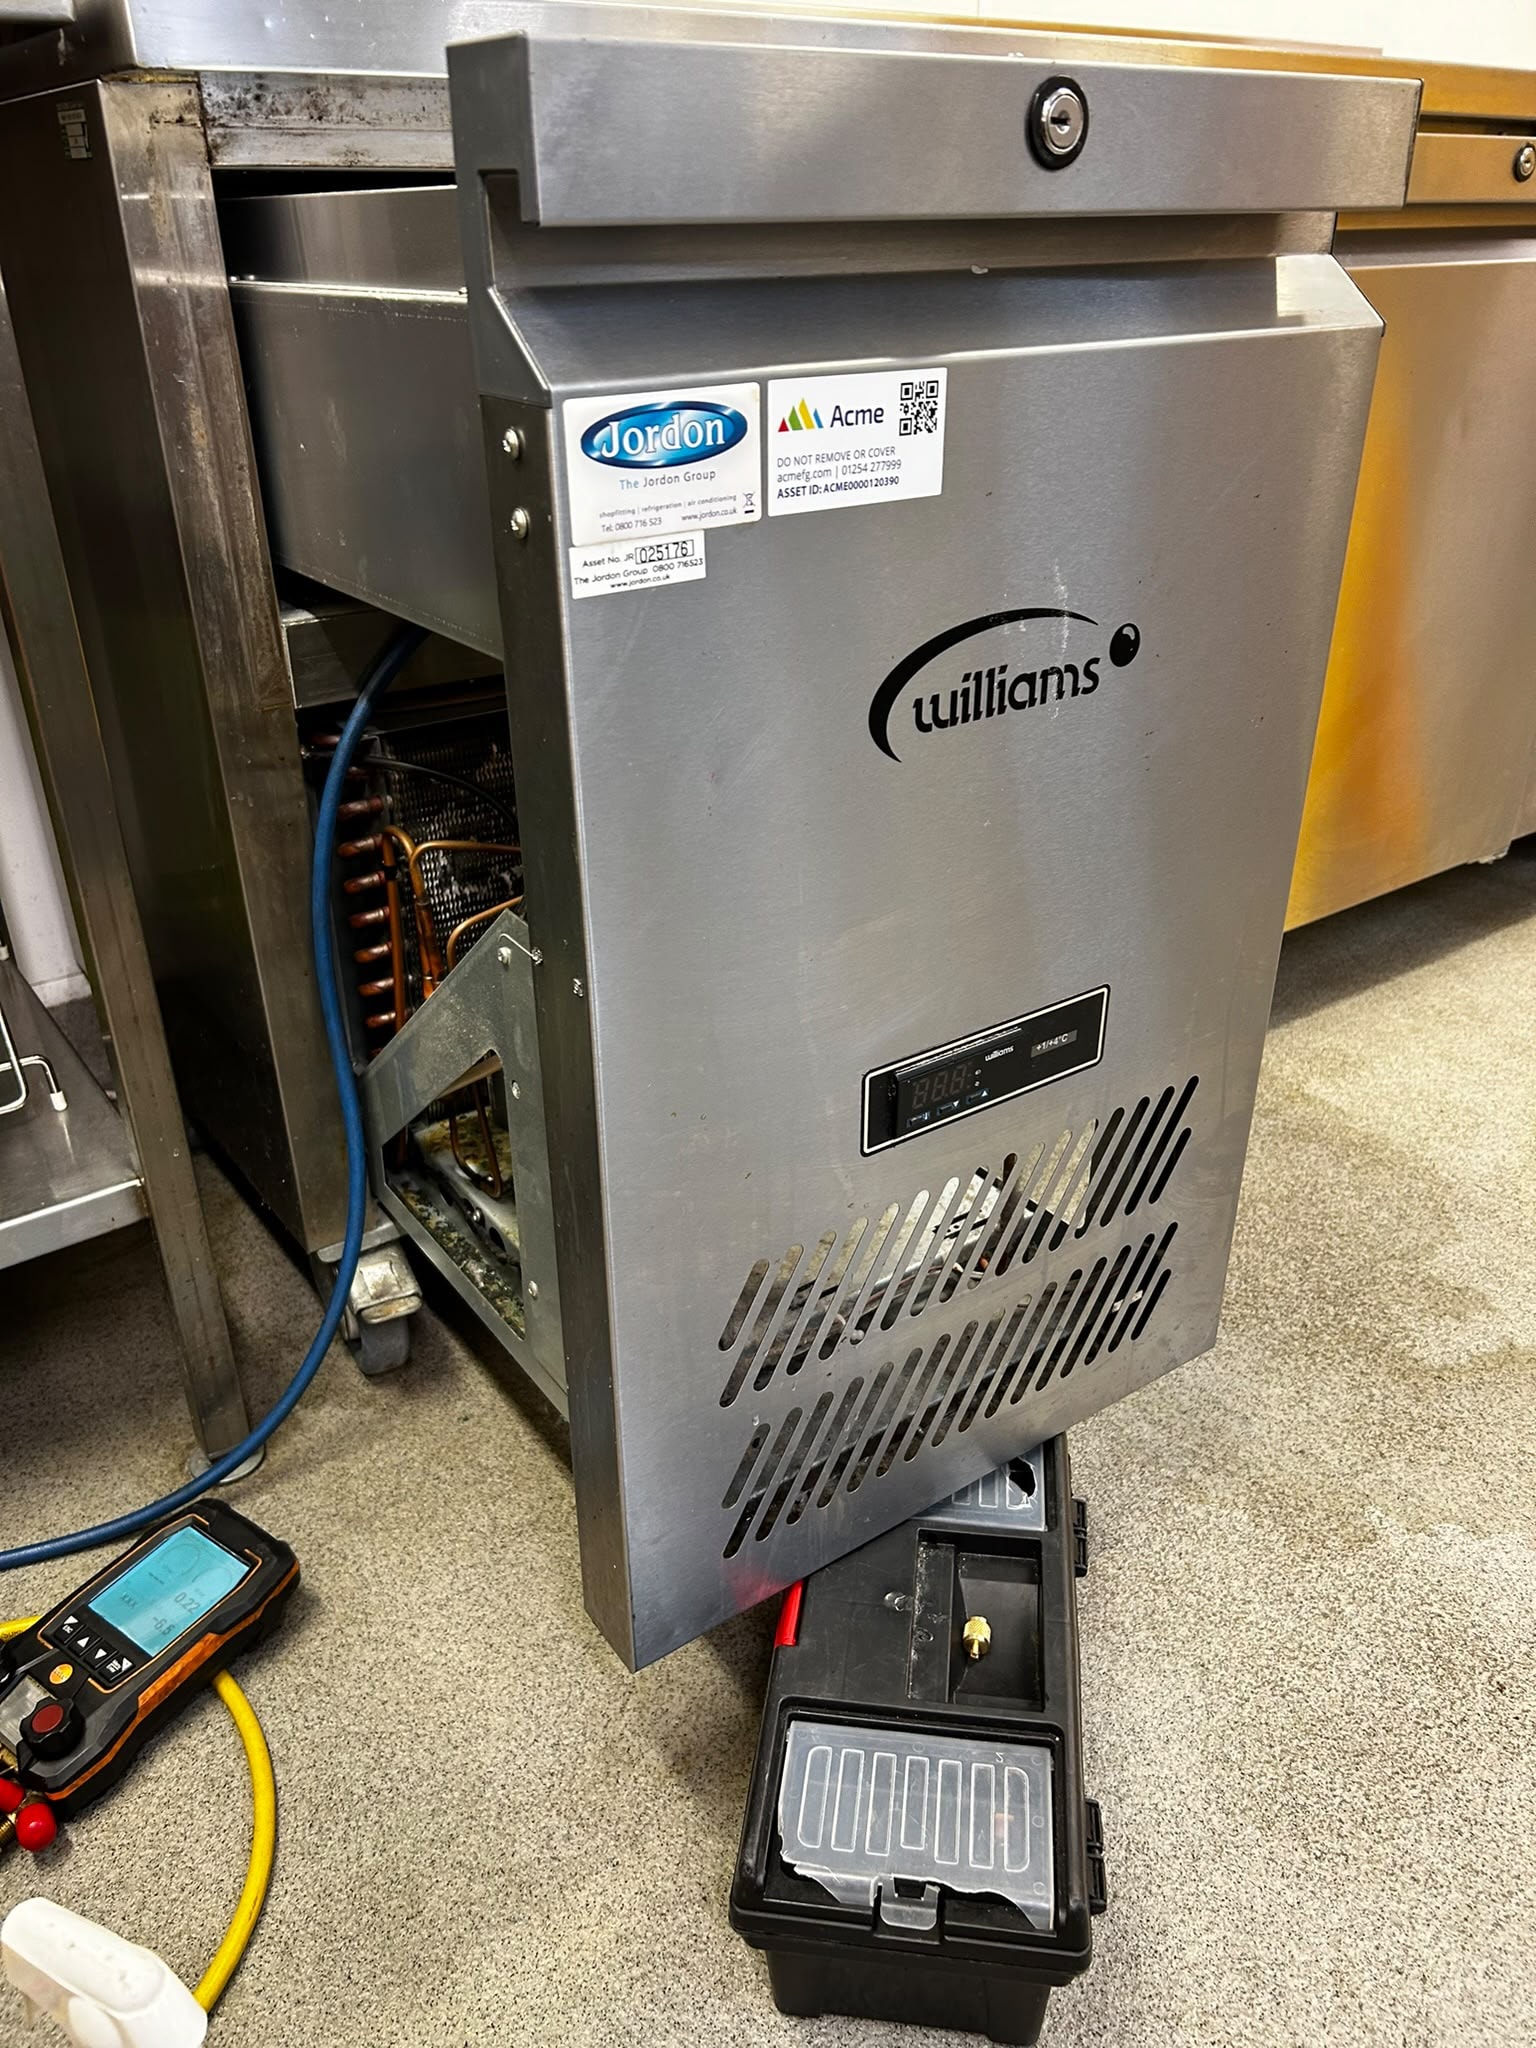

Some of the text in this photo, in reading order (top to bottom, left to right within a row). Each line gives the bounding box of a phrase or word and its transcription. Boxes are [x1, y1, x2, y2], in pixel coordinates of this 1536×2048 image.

[830, 405, 885, 428] Acme
[601, 413, 725, 458] Jordon
[777, 446, 896, 468] DO NOT REMOVE OR COVER
[619, 469, 716, 490] The Jordon Group
[777, 468, 832, 483] acmefg.com
[841, 464, 868, 476] 01254
[870, 459, 902, 474] 277999
[777, 476, 900, 499] ASSET ID: ACME0000120390
[641, 501, 682, 513] refrigeration
[687, 499, 697, 507] air
[697, 494, 737, 505] conditioning
[681, 507, 737, 521] www.jordon.co.uk
[615, 521, 633, 531] 0800
[635, 519, 648, 529] 716
[649, 517, 662, 527] 523
[582, 558, 605, 568] Asset
[624, 553, 634, 562] JR
[639, 541, 689, 564] 025176
[574, 558, 703, 585] The Jordon Group 0800 716523
[610, 575, 670, 588] www.jordon.co.uk
[912, 657, 1100, 733] williams
[985, 1045, 1014, 1061] williams
[174, 1591, 200, 1615] 0.22
